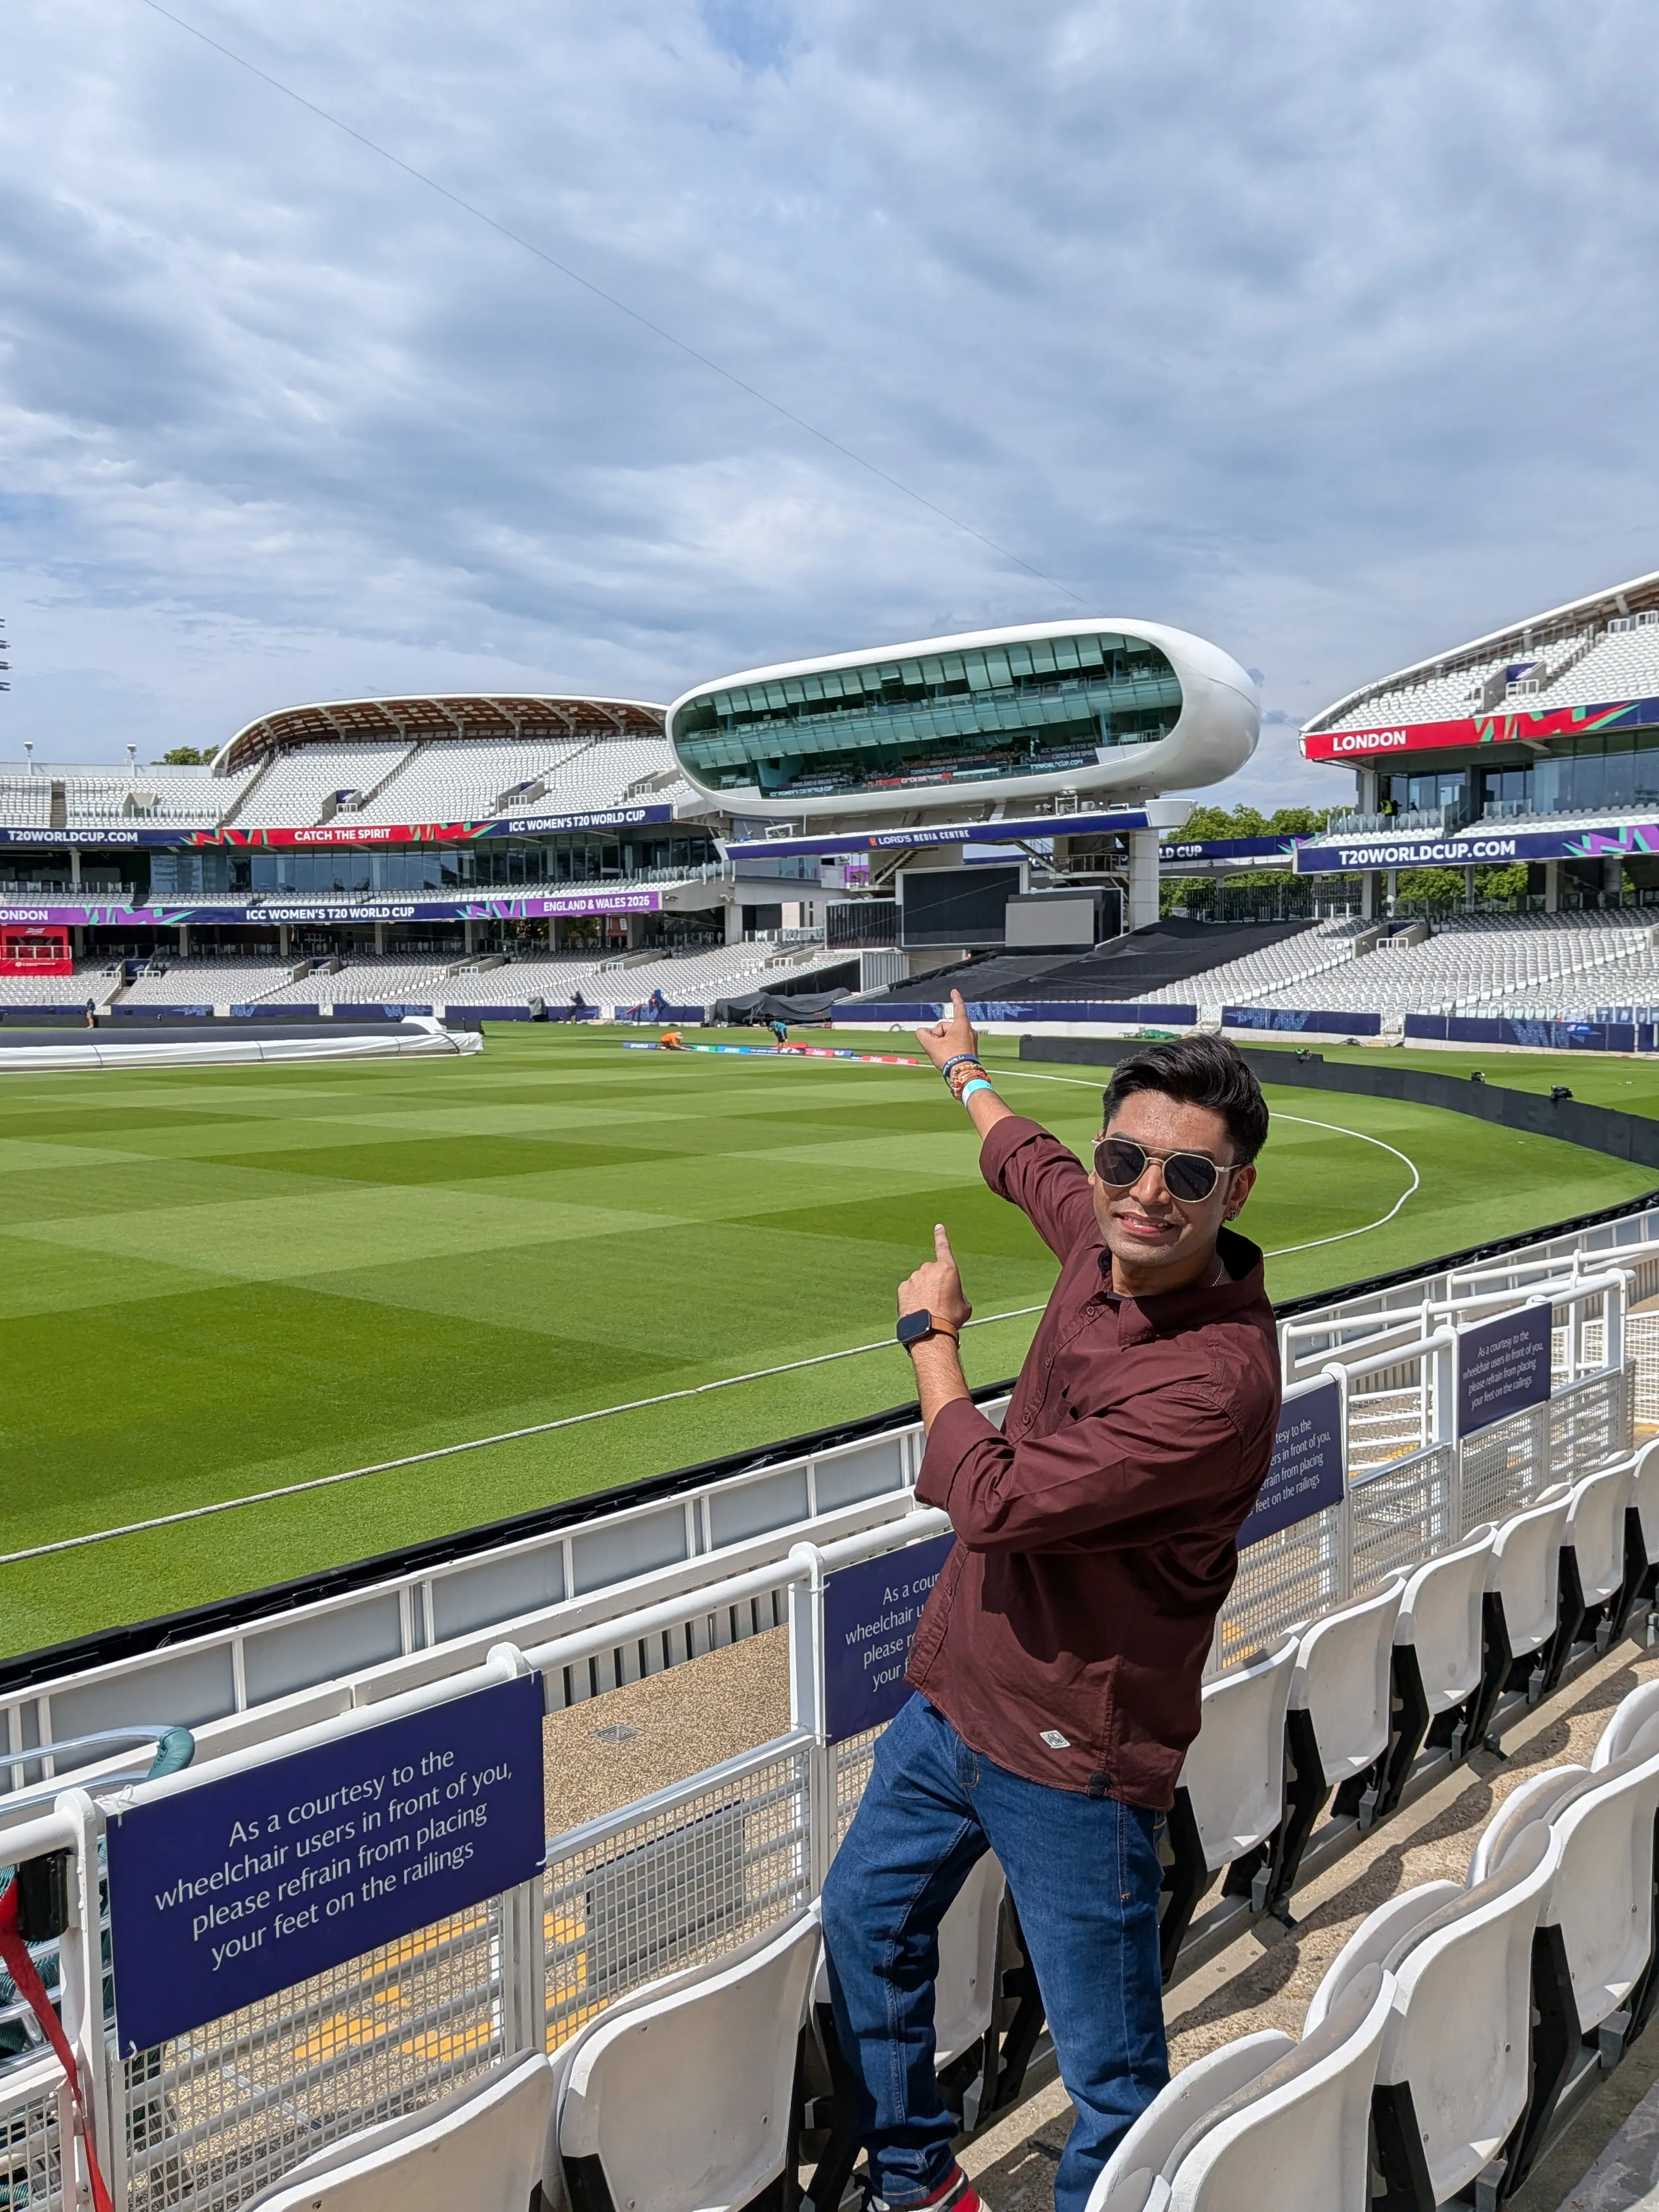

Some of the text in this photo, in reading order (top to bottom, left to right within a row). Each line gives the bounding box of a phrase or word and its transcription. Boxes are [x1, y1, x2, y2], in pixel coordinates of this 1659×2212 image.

[1332, 730, 1406, 752] LONDON
[294, 828, 391, 841] CATCH THE SPIRIT
[509, 810, 645, 832] ICC WOMEN'S T20 WORLD CUP
[7, 830, 138, 842] T20WORLDCUP.COM
[878, 830, 971, 845] LORD'S MEDIA CENTRE
[1176, 844, 1202, 858] CUP
[1339, 840, 1515, 866] T20WORLDCUP.COM
[0, 910, 49, 920] ONDON
[246, 906, 415, 920] ICC WOMEN'S T20 WORLD CUP
[544, 895, 650, 912] ENGLAND & WALES 2026
[1478, 1331, 1529, 1358] As a courtesy to the
[1463, 1360, 1490, 1380] wheelchair
[1491, 1354, 1504, 1368] users
[1505, 1352, 1511, 1363] in
[1511, 1347, 1525, 1361] front
[1525, 1343, 1532, 1355] of
[1468, 1359, 1537, 1396] please refrain from placing
[1471, 1375, 1532, 1411] your feet on the railings
[1276, 1419, 1312, 1444] tesy to the
[1270, 1431, 1331, 1467] ers in front of you,
[1281, 1464, 1298, 1481] from
[1300, 1453, 1323, 1475] placing
[1255, 1474, 1319, 1513] feet on the railings
[883, 1573, 940, 1605] As a cour
[846, 1607, 914, 1646] wheelchair
[864, 1638, 903, 1670] please
[873, 1665, 901, 1692] your
[229, 1751, 454, 1847] As a courtesy to the
[155, 1763, 512, 1910] wheelchair users in front of you,
[193, 1803, 487, 1942] please refrain from placing
[211, 1842, 474, 1971] your feet on the railings
